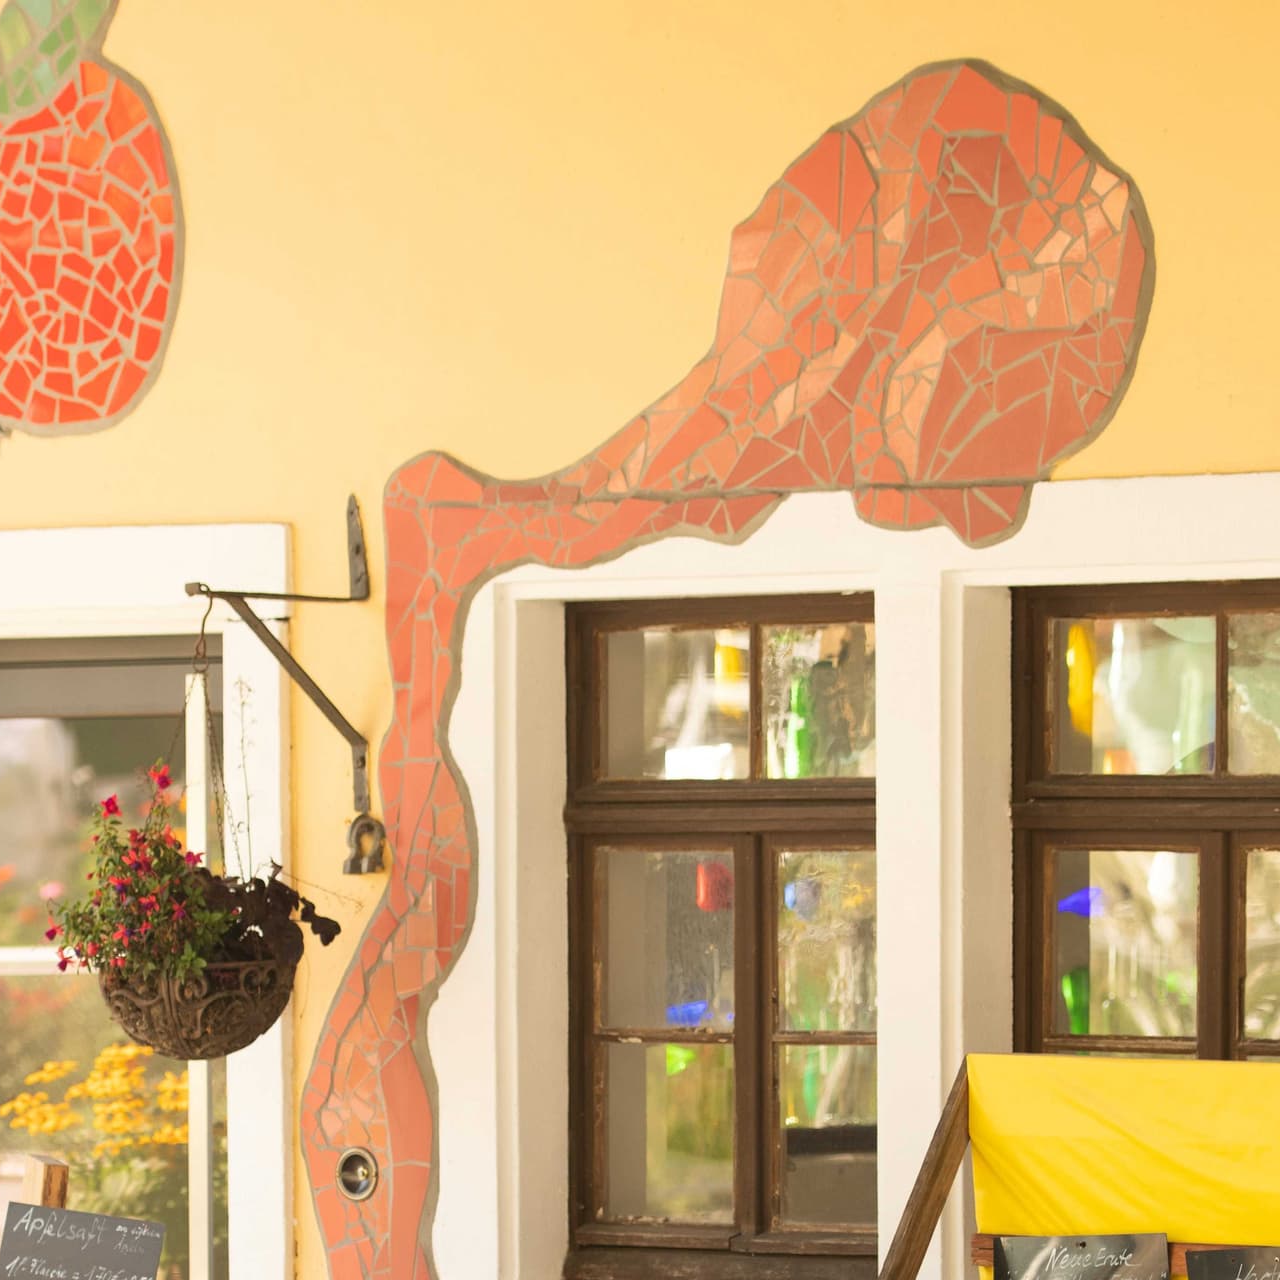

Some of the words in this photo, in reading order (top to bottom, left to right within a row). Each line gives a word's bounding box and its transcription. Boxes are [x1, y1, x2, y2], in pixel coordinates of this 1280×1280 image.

[13, 1207, 106, 1249] Apfelsaft
[1045, 1247, 1091, 1272] Neue
[1094, 1247, 1139, 1268] Ernte
